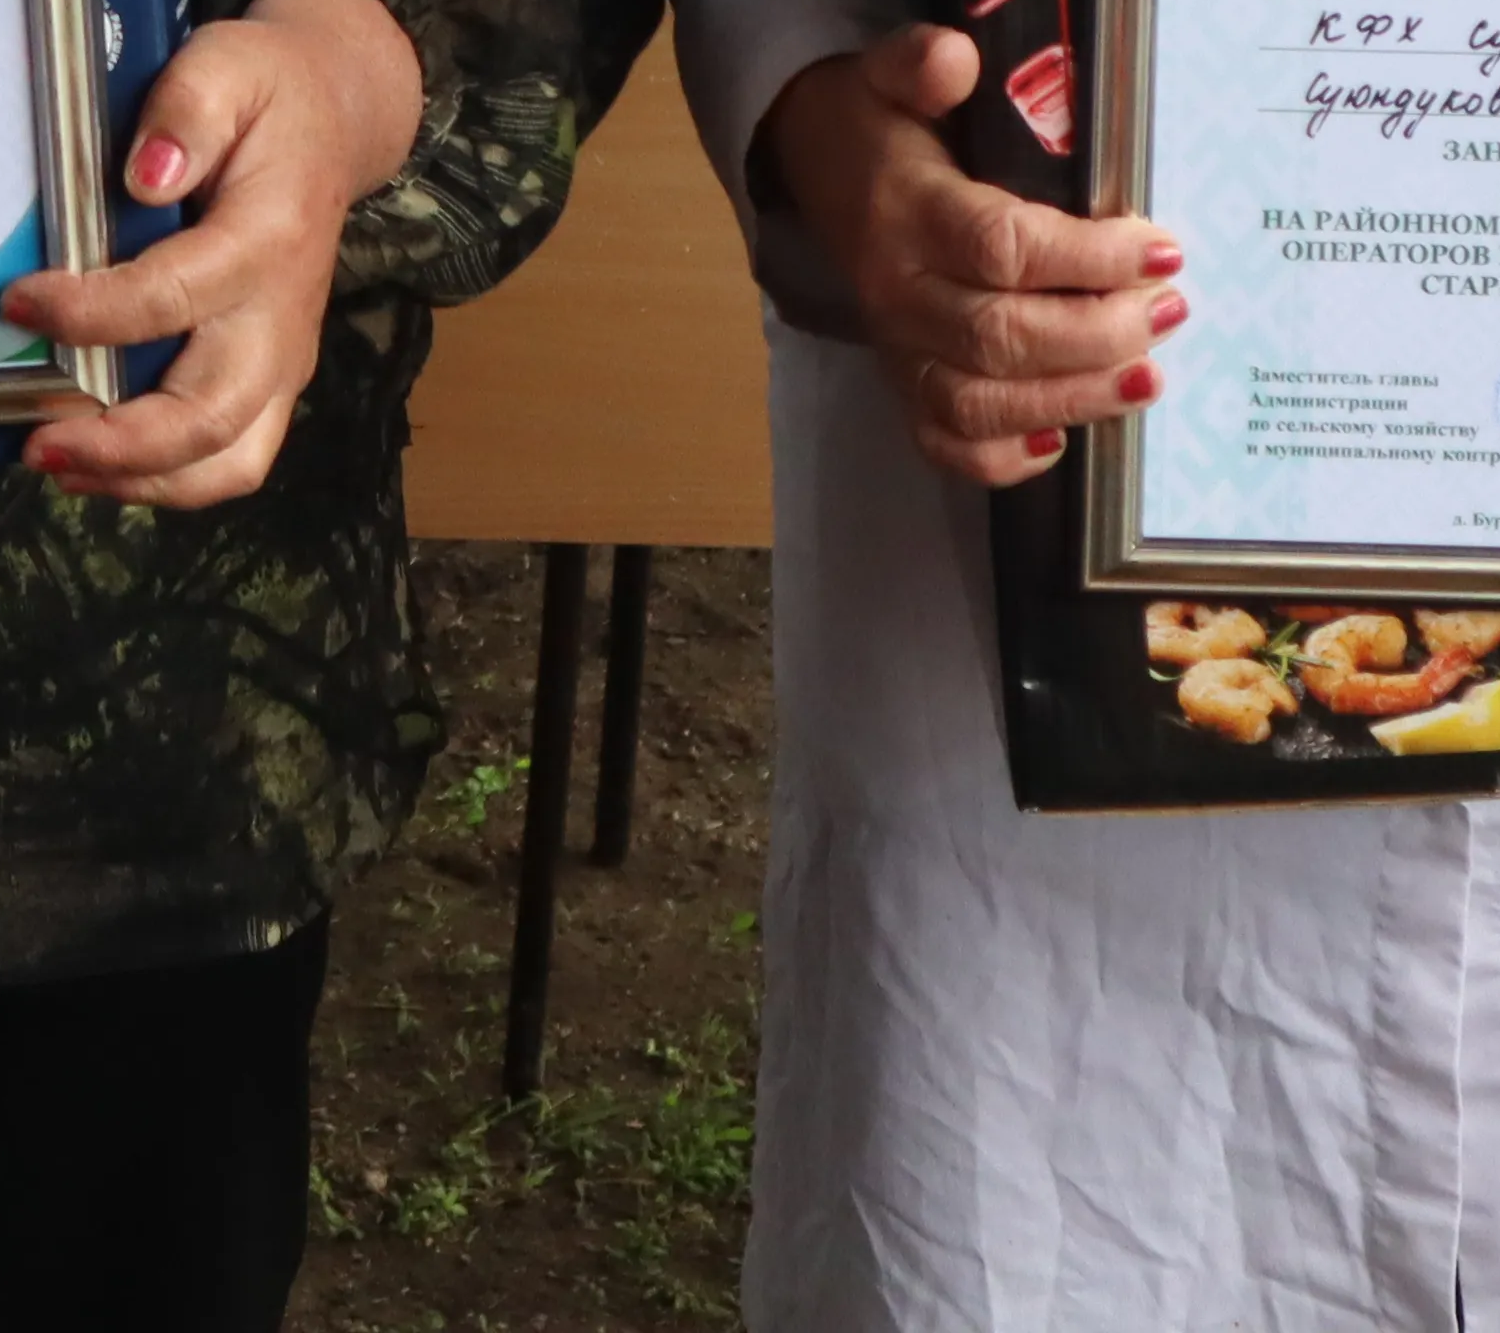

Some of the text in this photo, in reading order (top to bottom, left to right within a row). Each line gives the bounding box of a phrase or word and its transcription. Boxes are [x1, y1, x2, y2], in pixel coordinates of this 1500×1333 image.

[1310, 9, 1424, 47] КФХ
[1262, 209, 1305, 231] НА
[1314, 209, 1499, 236] РАЙОННОМ
[1282, 241, 1490, 266] ОПЕРАТОРОВ
